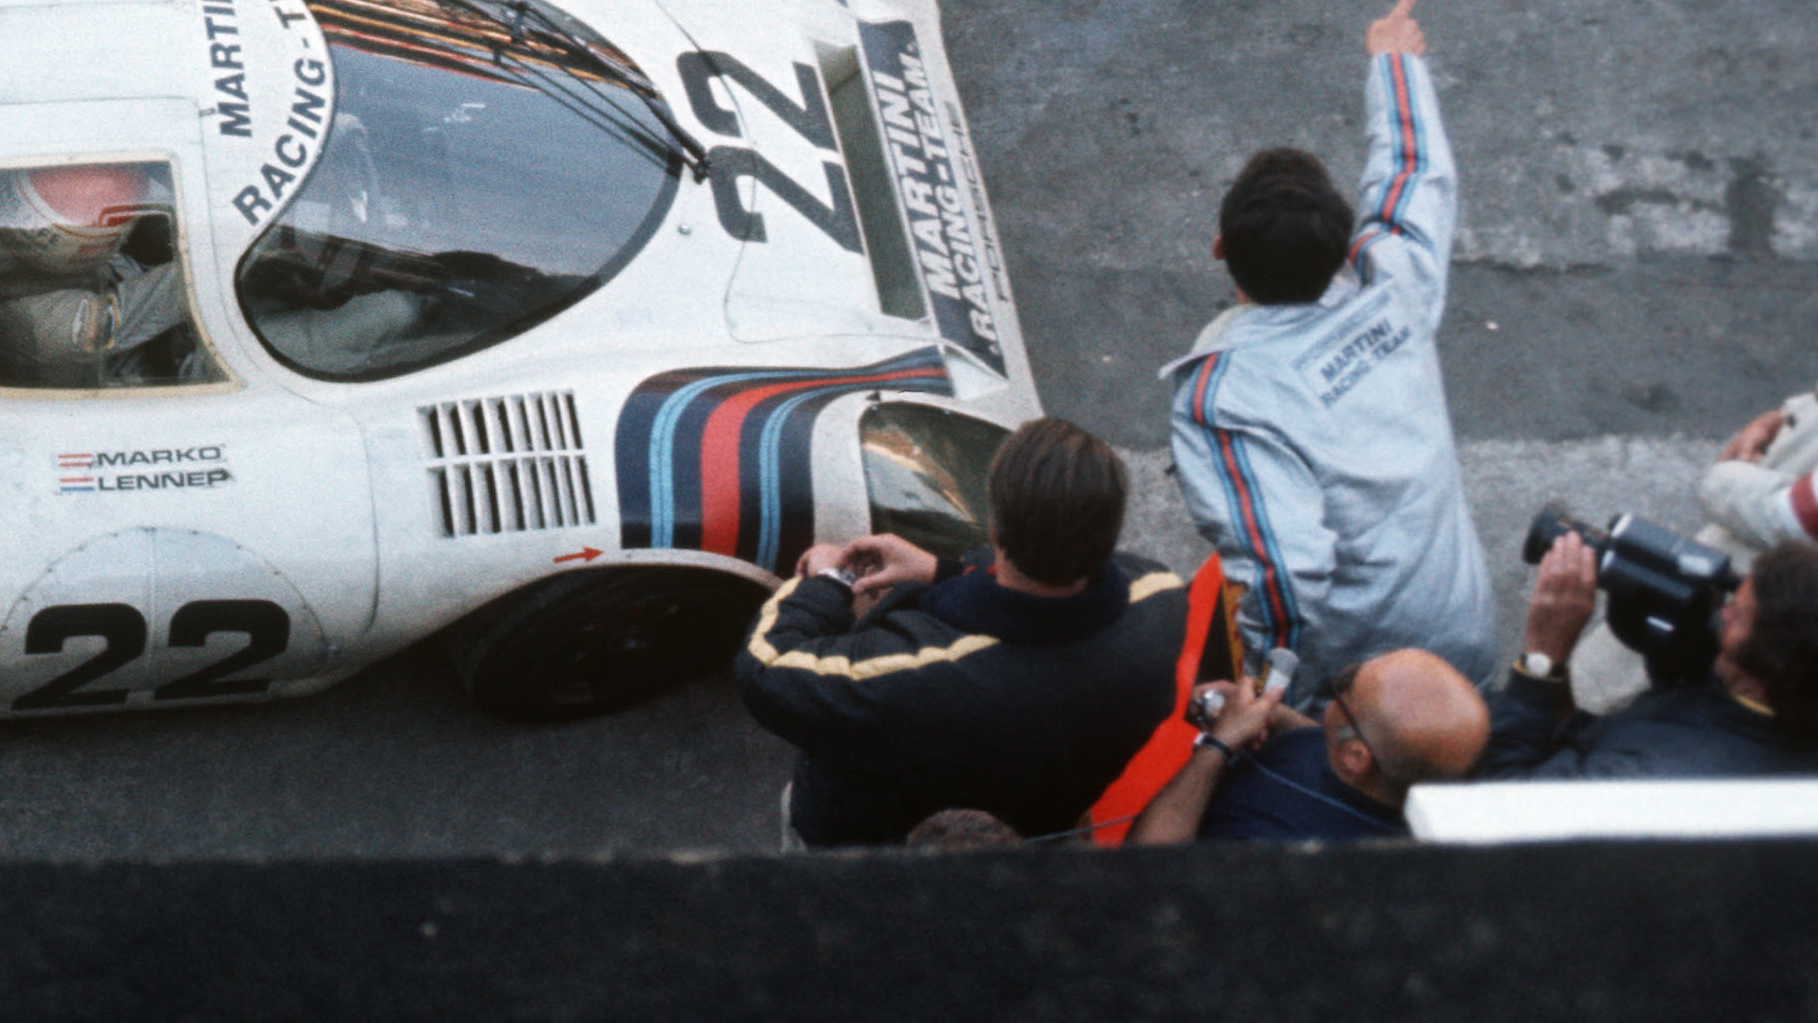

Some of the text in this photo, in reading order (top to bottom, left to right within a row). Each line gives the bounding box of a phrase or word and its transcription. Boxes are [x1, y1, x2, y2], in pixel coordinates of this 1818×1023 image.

[675, 50, 865, 257] 22
[872, 69, 962, 300] MARTINI
[1321, 316, 1393, 382] MARTINI
[1372, 325, 1411, 359] TEAM
[96, 446, 221, 466] MARKO
[98, 468, 231, 491] LENNEP
[10, 598, 291, 710] 22
